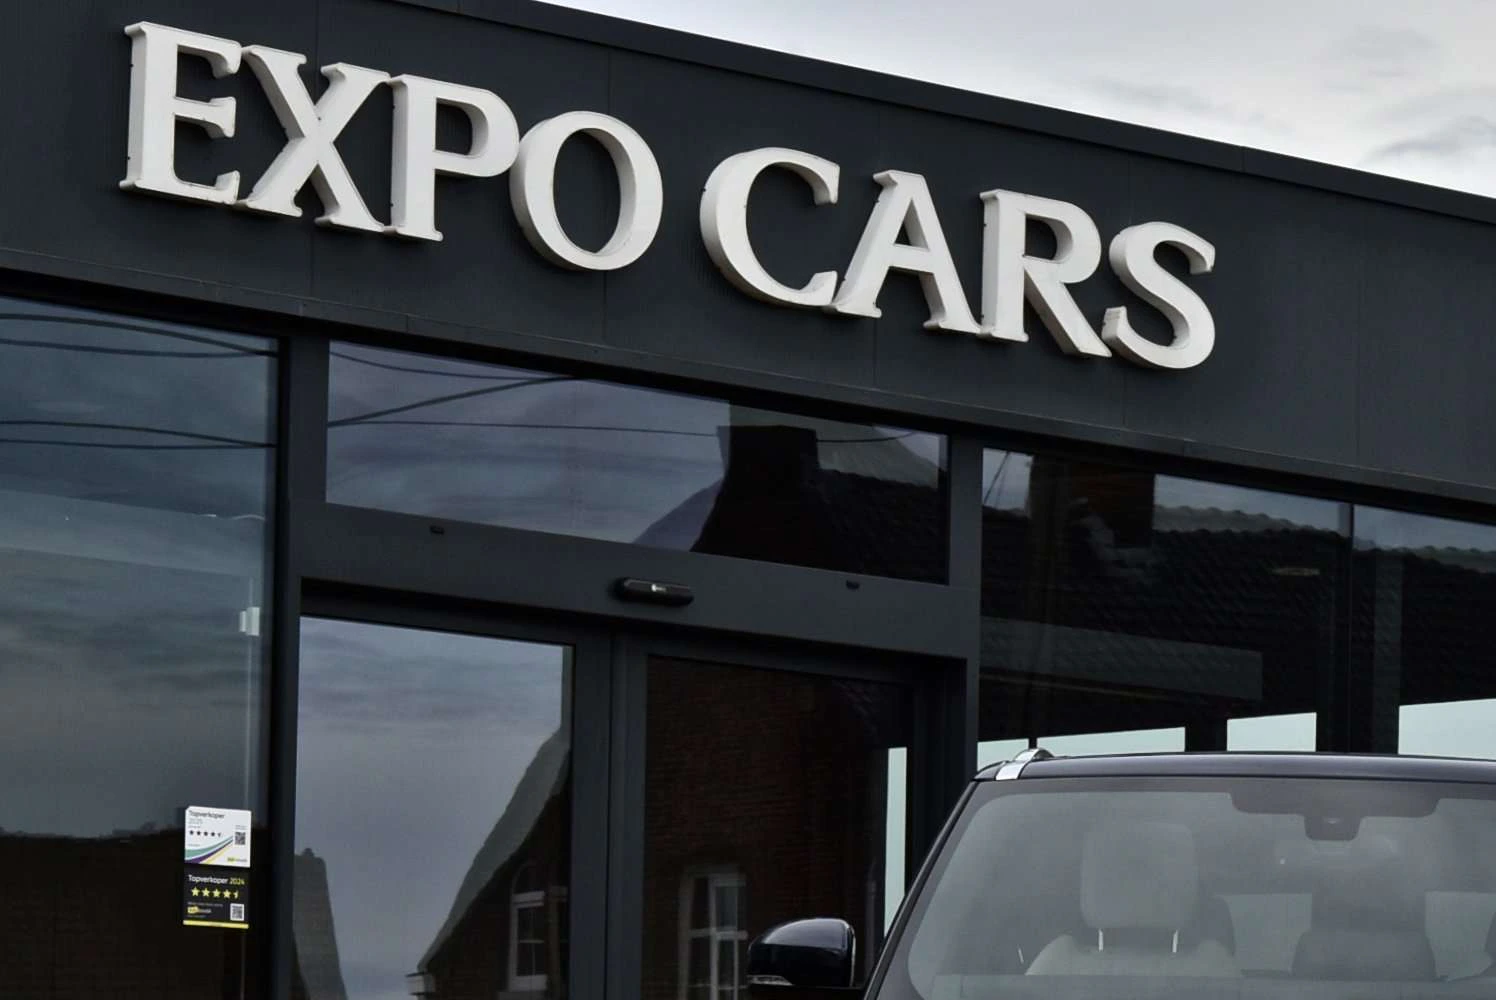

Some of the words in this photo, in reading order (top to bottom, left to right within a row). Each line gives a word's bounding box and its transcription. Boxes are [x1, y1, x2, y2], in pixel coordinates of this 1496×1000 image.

[119, 21, 664, 271] EXPO
[701, 147, 1216, 370] CARS
[188, 874, 229, 884] Topverkoper
